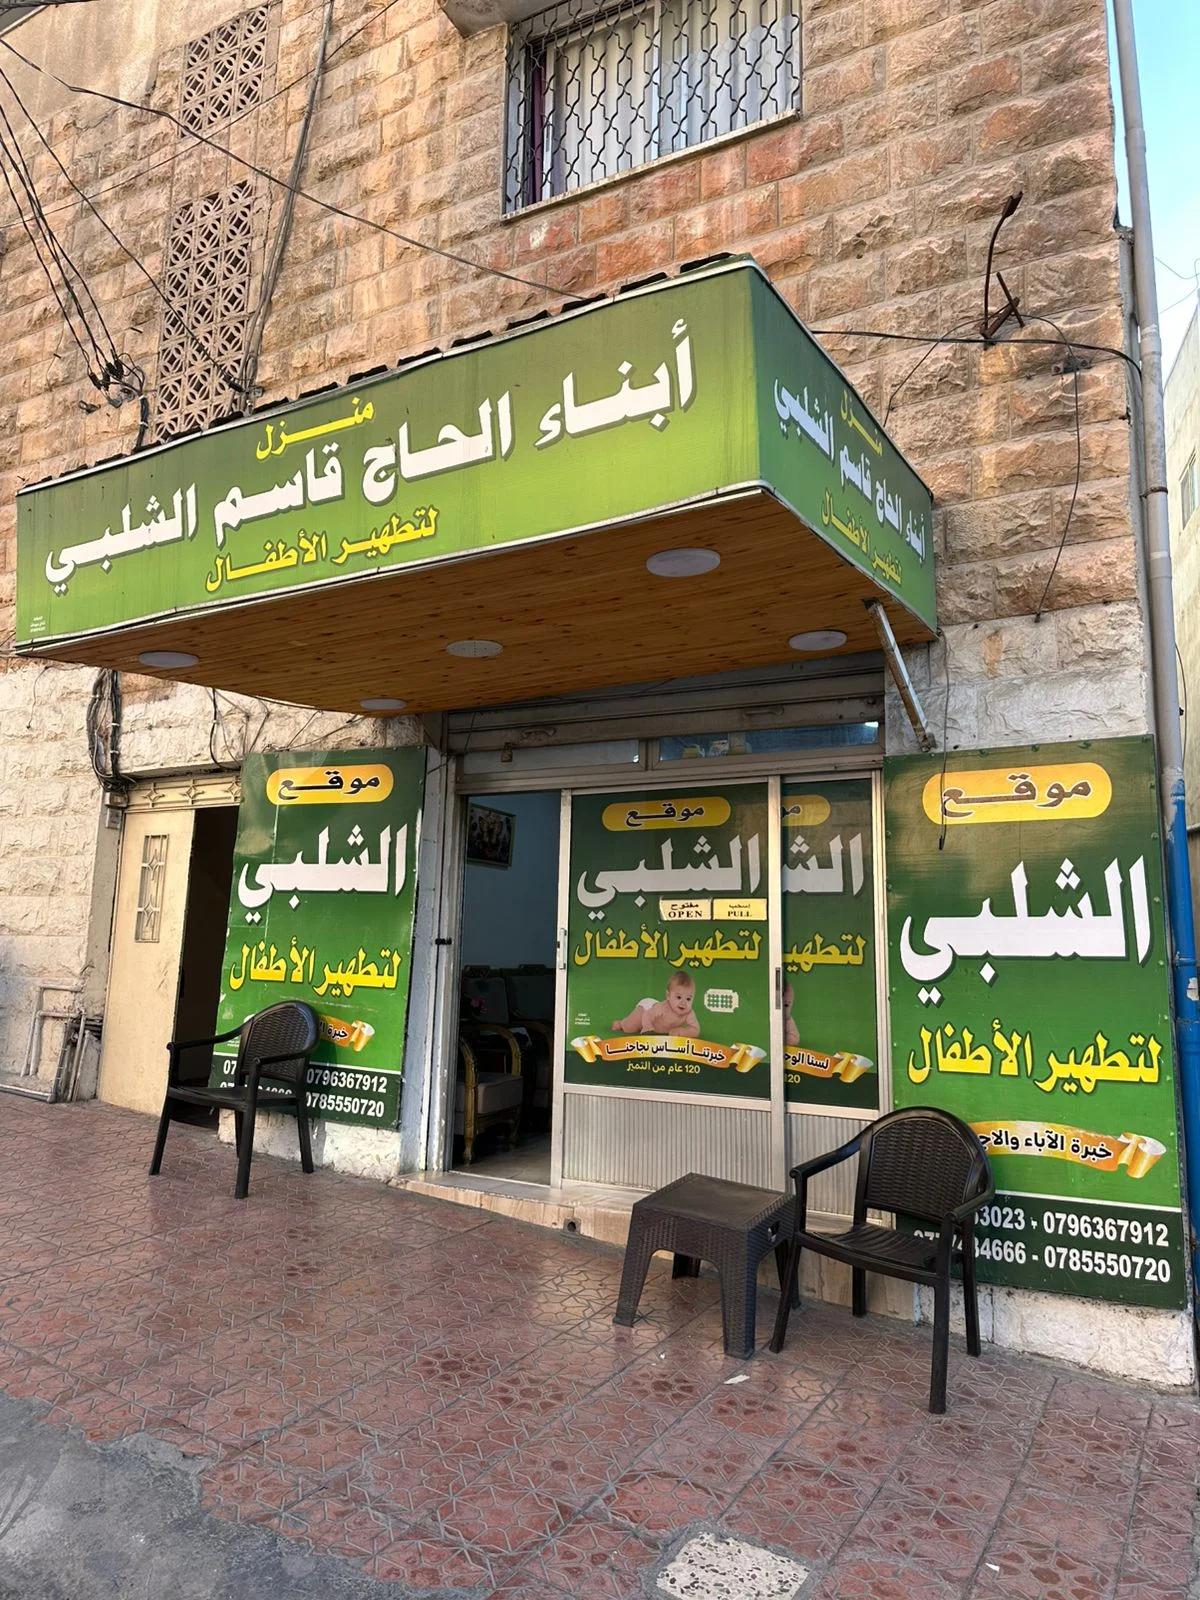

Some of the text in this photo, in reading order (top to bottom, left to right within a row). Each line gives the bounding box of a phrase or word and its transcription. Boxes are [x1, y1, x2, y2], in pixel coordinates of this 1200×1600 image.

[257, 397, 375, 460] منزل
[841, 389, 883, 456] منزل
[45, 318, 695, 593] أبناء الحاج قاسم الشلبي
[774, 379, 926, 565] أبناء الحاج قاسم الشلبي
[821, 487, 869, 554] الأطفال
[205, 505, 438, 592] لتطهير الأطفال
[277, 769, 381, 801] موقع
[942, 773, 1093, 818] موقع
[625, 802, 705, 827] موقع
[237, 823, 408, 925] الشلبي
[577, 832, 761, 922] الشلبي
[782, 832, 864, 896] الش
[668, 910, 703, 919] OPEN
[900, 855, 1151, 1006] الشلبي
[229, 936, 402, 998] لتطهير الأطفال
[574, 923, 763, 968] لتطهير الأطفال
[783, 932, 867, 973] لتطهي
[327, 1023, 348, 1041] خبرة
[606, 1040, 725, 1064] خبرتنا أساس نجاحنا
[627, 1061, 701, 1075] 120 عام من التميز
[783, 1052, 829, 1070] لسنا الوح
[908, 1018, 1164, 1094] لتطهير الأطفال
[306, 1068, 388, 1094] 0796367912
[979, 1129, 1113, 1161] خبرة الآباء والاج
[1043, 1211, 1169, 1247] 0796367912
[1044, 1246, 1171, 1283] 0785550720
